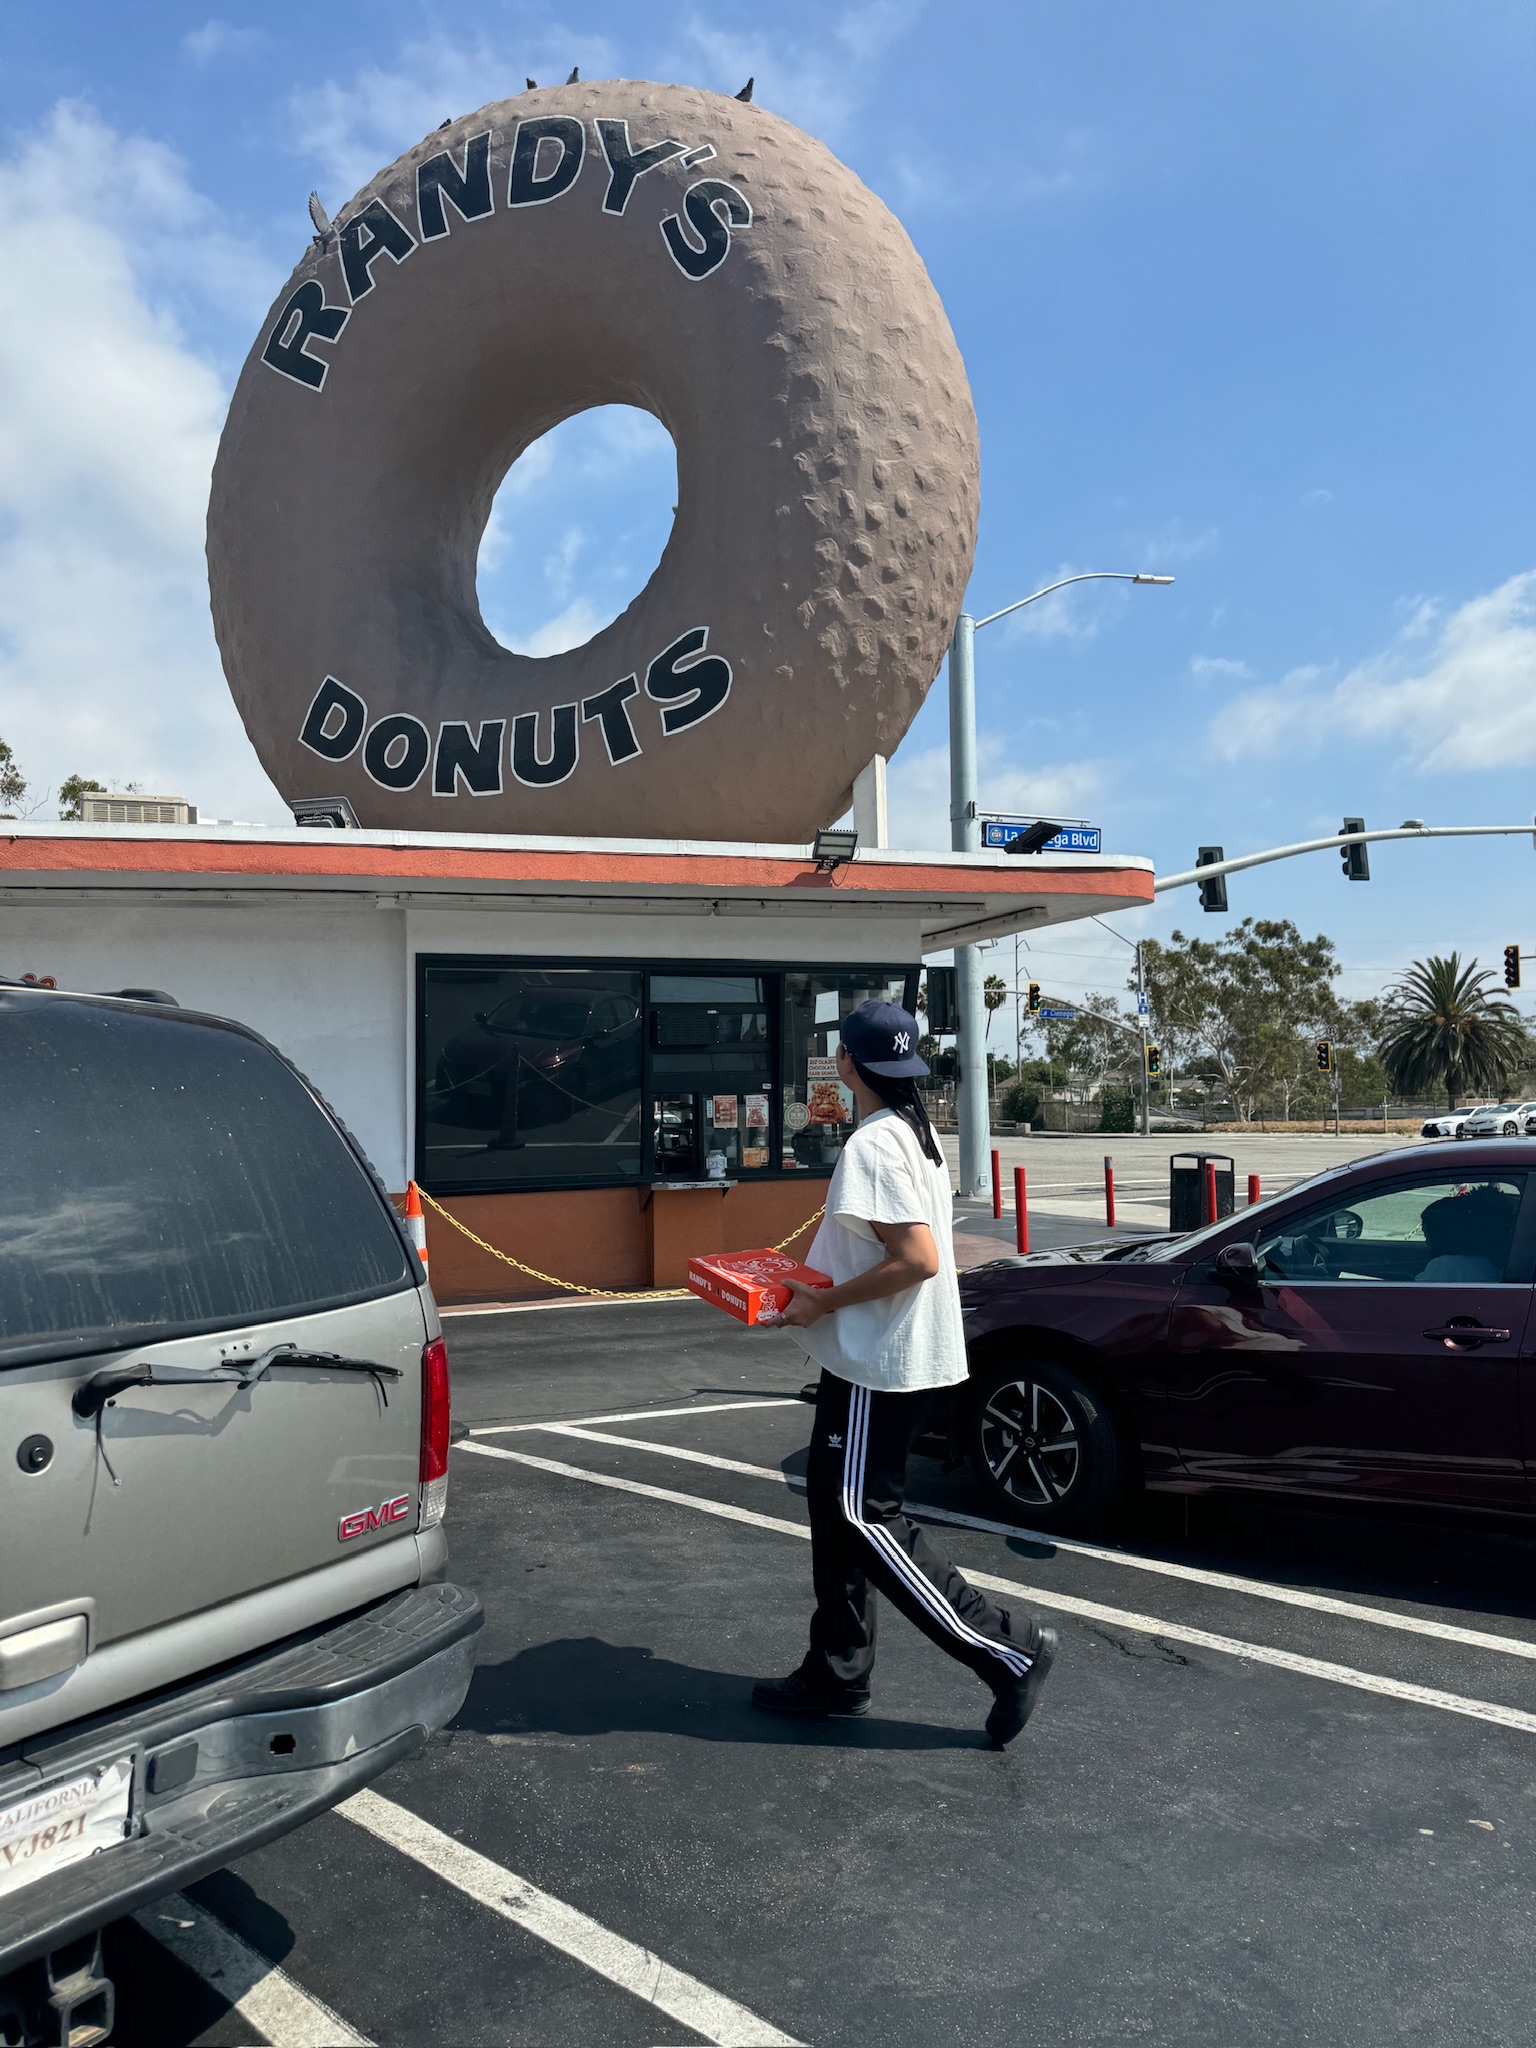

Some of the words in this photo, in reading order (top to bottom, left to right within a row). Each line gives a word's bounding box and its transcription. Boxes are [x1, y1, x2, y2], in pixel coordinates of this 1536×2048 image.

[261, 115, 753, 392] RANDY'S
[298, 626, 733, 797] DONUTS
[1004, 829, 1019, 842] La
[1071, 832, 1097, 847] Blvd
[892, 1031, 911, 1054] NY
[688, 1271, 712, 1292] RANDY'S
[721, 1290, 748, 1312] DONUTS
[339, 1493, 409, 1540] GMC
[0, 1780, 100, 1830] ALIFORNIA
